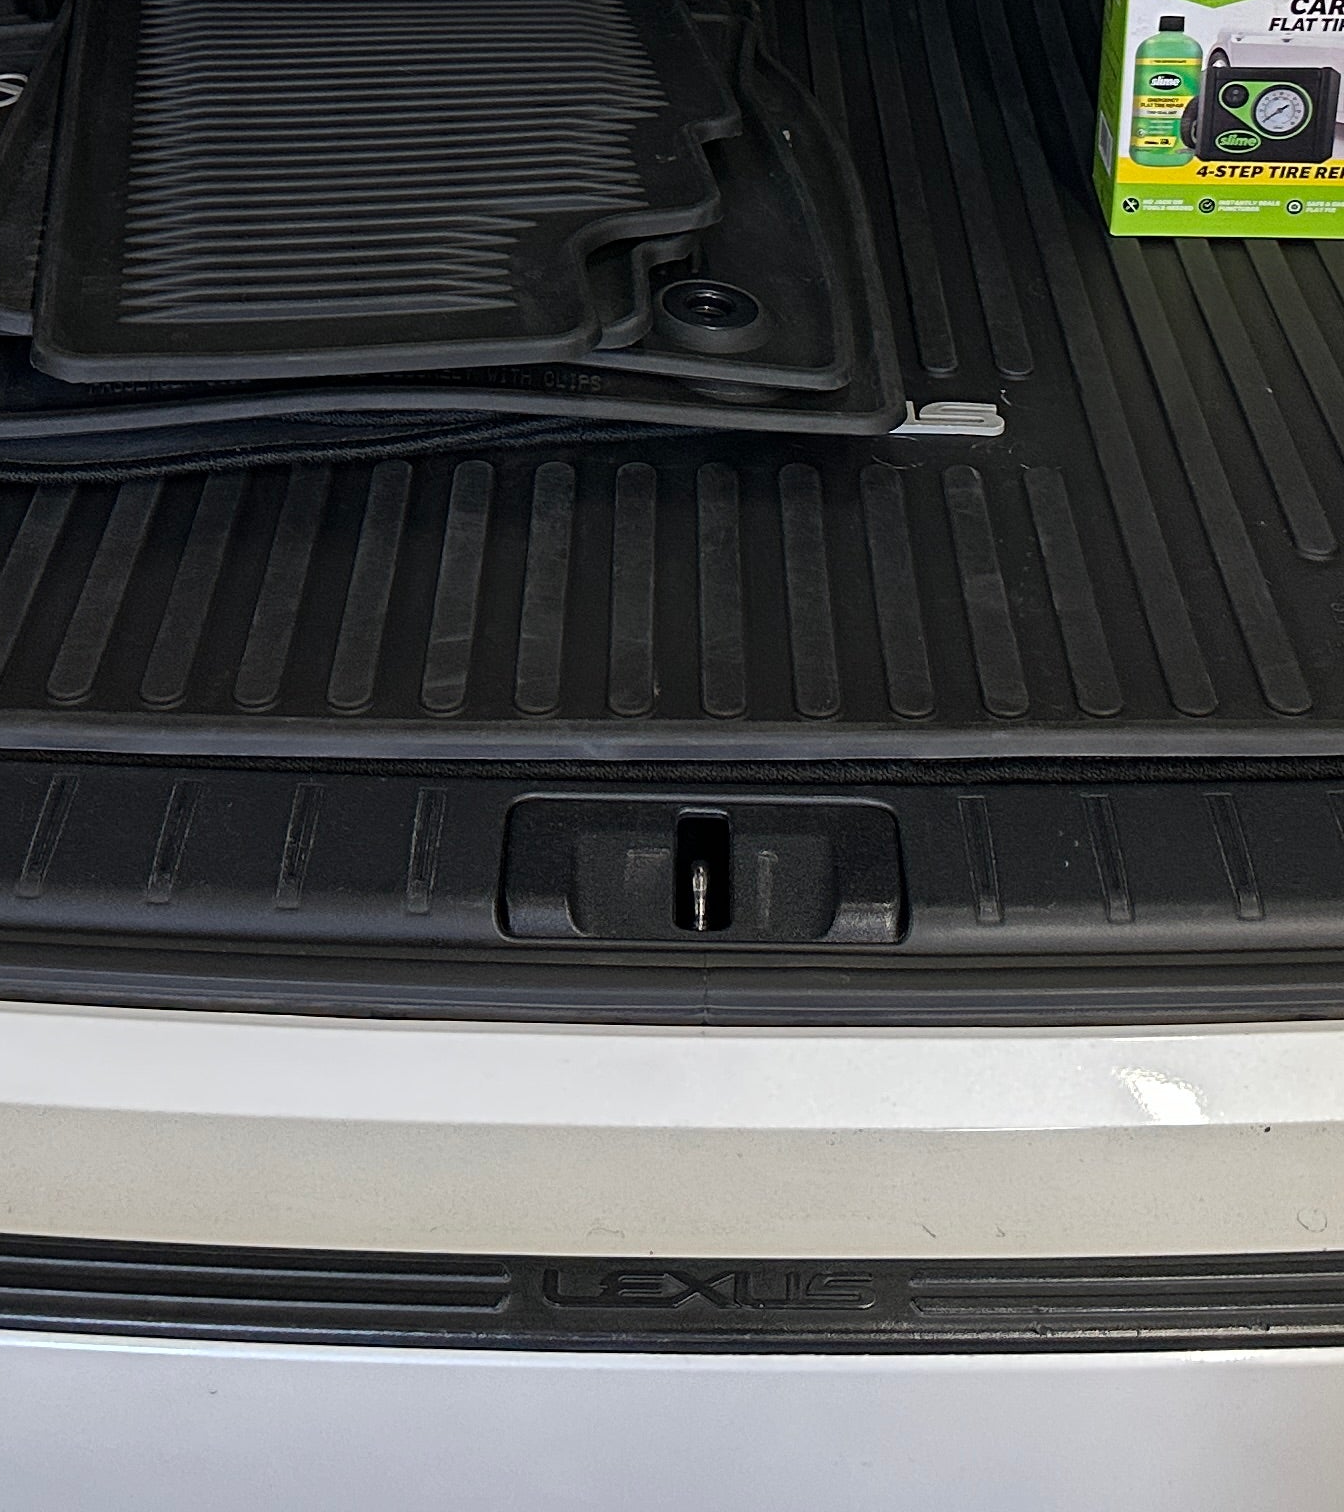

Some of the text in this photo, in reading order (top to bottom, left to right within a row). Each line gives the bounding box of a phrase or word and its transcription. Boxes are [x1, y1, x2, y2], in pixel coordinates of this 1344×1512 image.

[1268, 17, 1319, 32] FLAT
[1150, 75, 1181, 87] slime
[1219, 134, 1257, 147] slime
[1196, 165, 1264, 178] 4-STEP
[1268, 166, 1311, 179] TIRE
[543, 370, 602, 392] CLIPS
[542, 1267, 877, 1310] LEXUS
